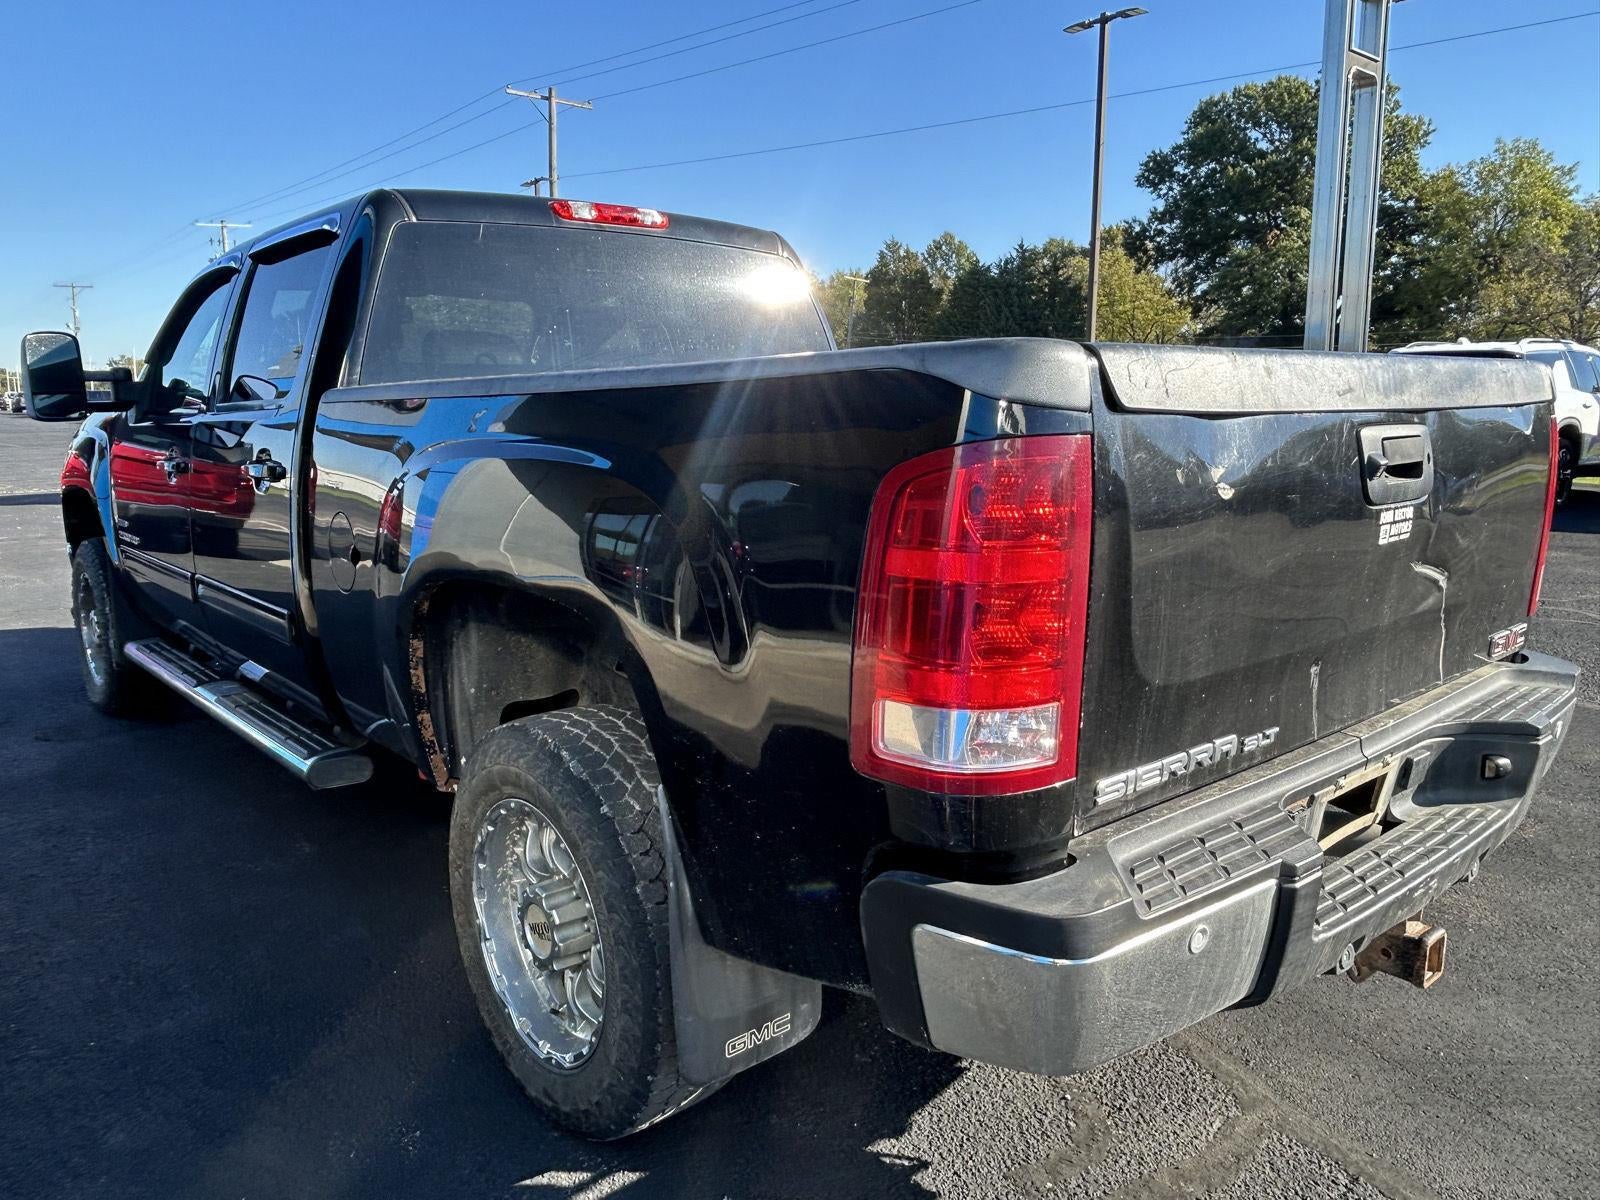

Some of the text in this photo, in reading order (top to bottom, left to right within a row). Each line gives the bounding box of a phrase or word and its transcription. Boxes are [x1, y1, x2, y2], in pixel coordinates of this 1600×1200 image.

[1490, 622, 1528, 658] GMC
[1094, 726, 1280, 806] SIERRA SLT
[528, 920, 550, 935] MOTO
[725, 1012, 791, 1058] GMC
